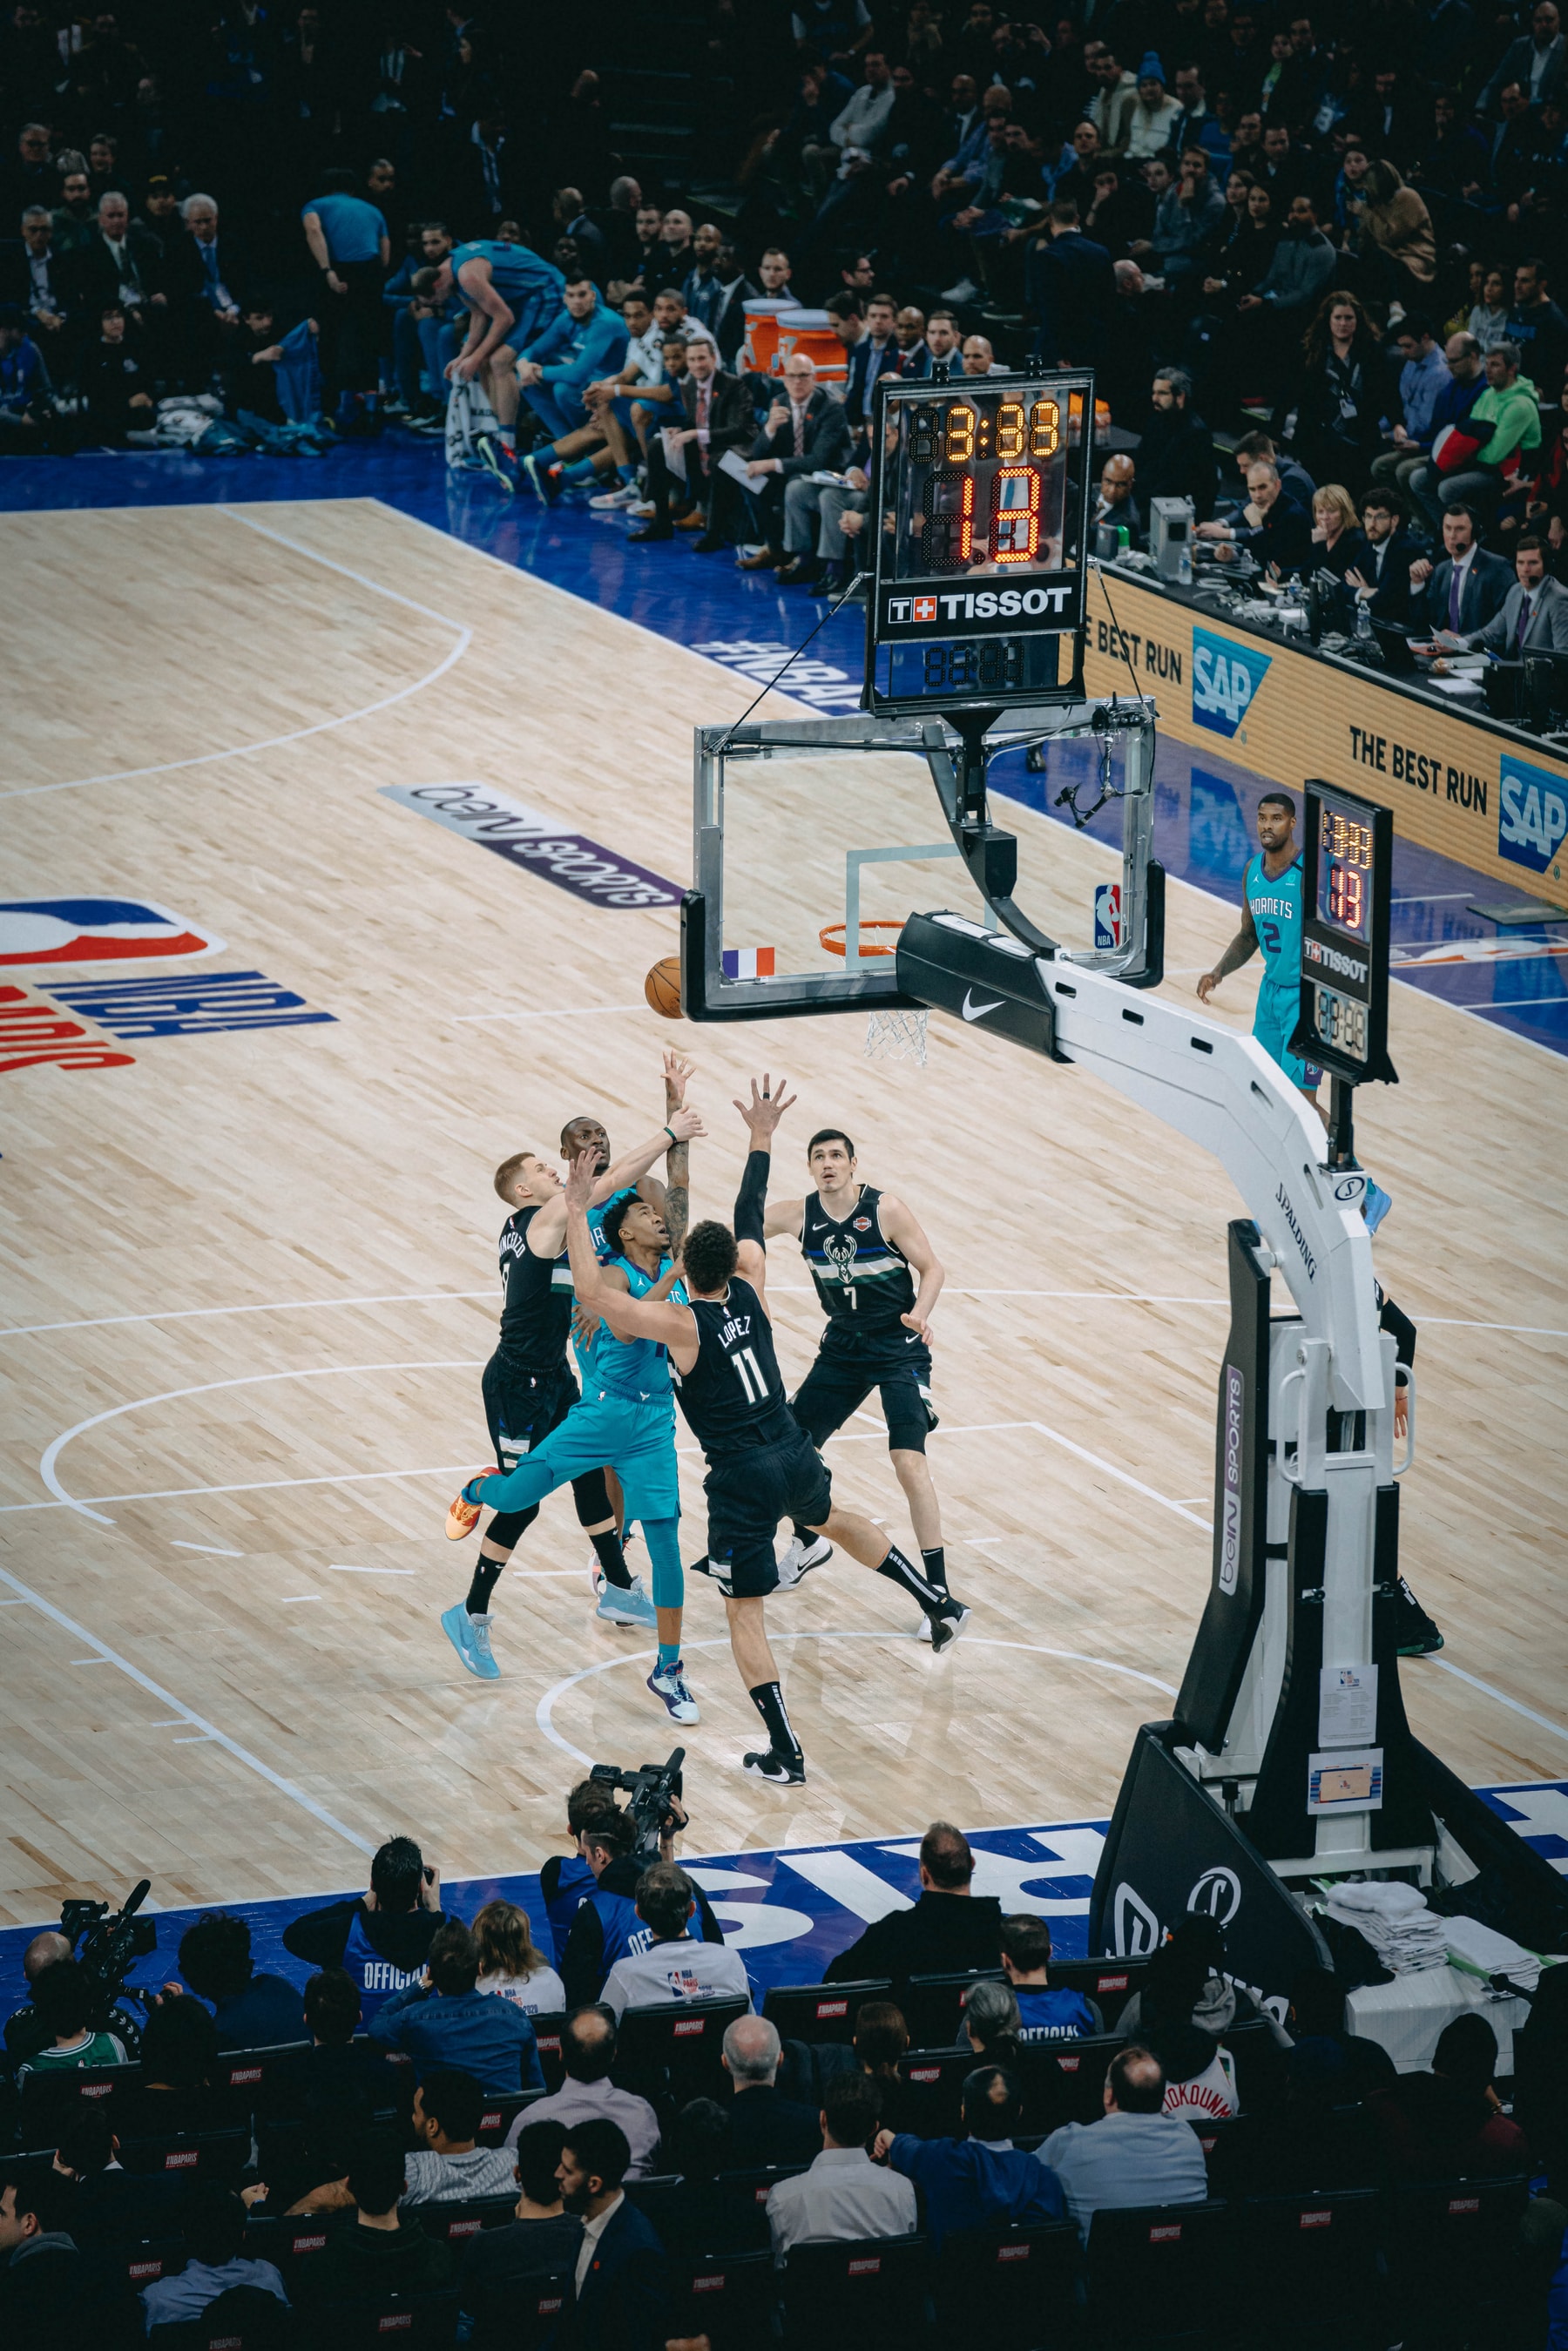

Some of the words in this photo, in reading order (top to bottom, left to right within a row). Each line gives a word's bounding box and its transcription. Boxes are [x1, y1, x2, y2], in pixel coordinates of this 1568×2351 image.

[947, 401, 1059, 462] 3:33
[961, 467, 1040, 564] 13
[940, 587, 1072, 619] TISSOT
[1098, 619, 1141, 667] BEST
[1146, 639, 1182, 685] RUN
[1193, 645, 1252, 723] SAP
[1349, 725, 1387, 774] THE
[1392, 744, 1442, 794] BEST
[1447, 767, 1488, 816] RUN
[1500, 775, 1567, 857] SAP
[511, 841, 676, 906] SPORTS
[1250, 897, 1293, 919] HORNETS
[1098, 935, 1111, 946] NBA
[1262, 922, 1281, 953] 2
[1321, 946, 1368, 983] TISSOT
[32, 970, 341, 1040] NBA
[1275, 1181, 1317, 1285] SPALDING
[843, 1287, 857, 1310] 7
[717, 1315, 751, 1349] LOPEZ
[731, 1346, 770, 1405] 11
[1227, 1377, 1241, 1485] SPORTS
[504, 1988, 517, 1997] NBA
[524, 2004, 538, 2015] 2020
[232, 2070, 262, 2081] #NBAPARIS
[166, 2153, 197, 2165] #NBAPARIS
[294, 2236, 325, 2248] #NBAPARIS
[130, 2262, 162, 2274] #NBAPARIS
